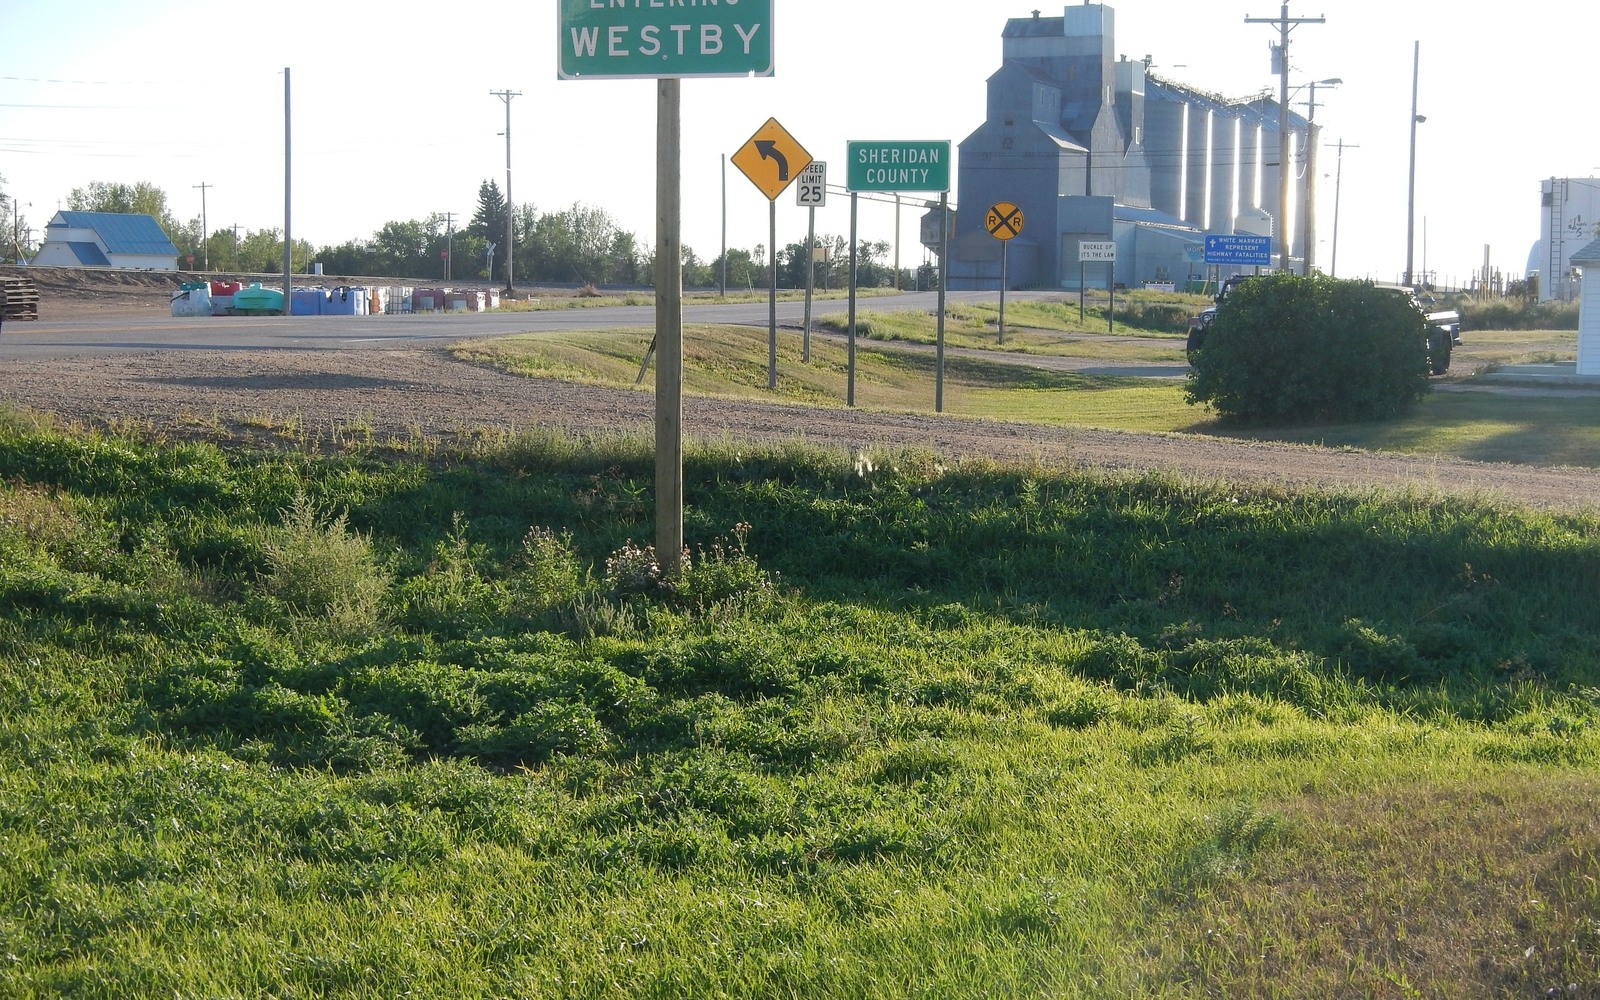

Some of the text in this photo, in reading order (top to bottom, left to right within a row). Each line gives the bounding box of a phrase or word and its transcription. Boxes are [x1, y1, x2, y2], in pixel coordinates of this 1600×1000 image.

[571, 24, 760, 57] WESTBY
[859, 149, 939, 164] SHERIDAN
[803, 165, 824, 174] PEED
[866, 169, 929, 184] COUNTY
[801, 175, 822, 184] LIMIT
[800, 185, 822, 202] 25
[988, 215, 1021, 227] R R
